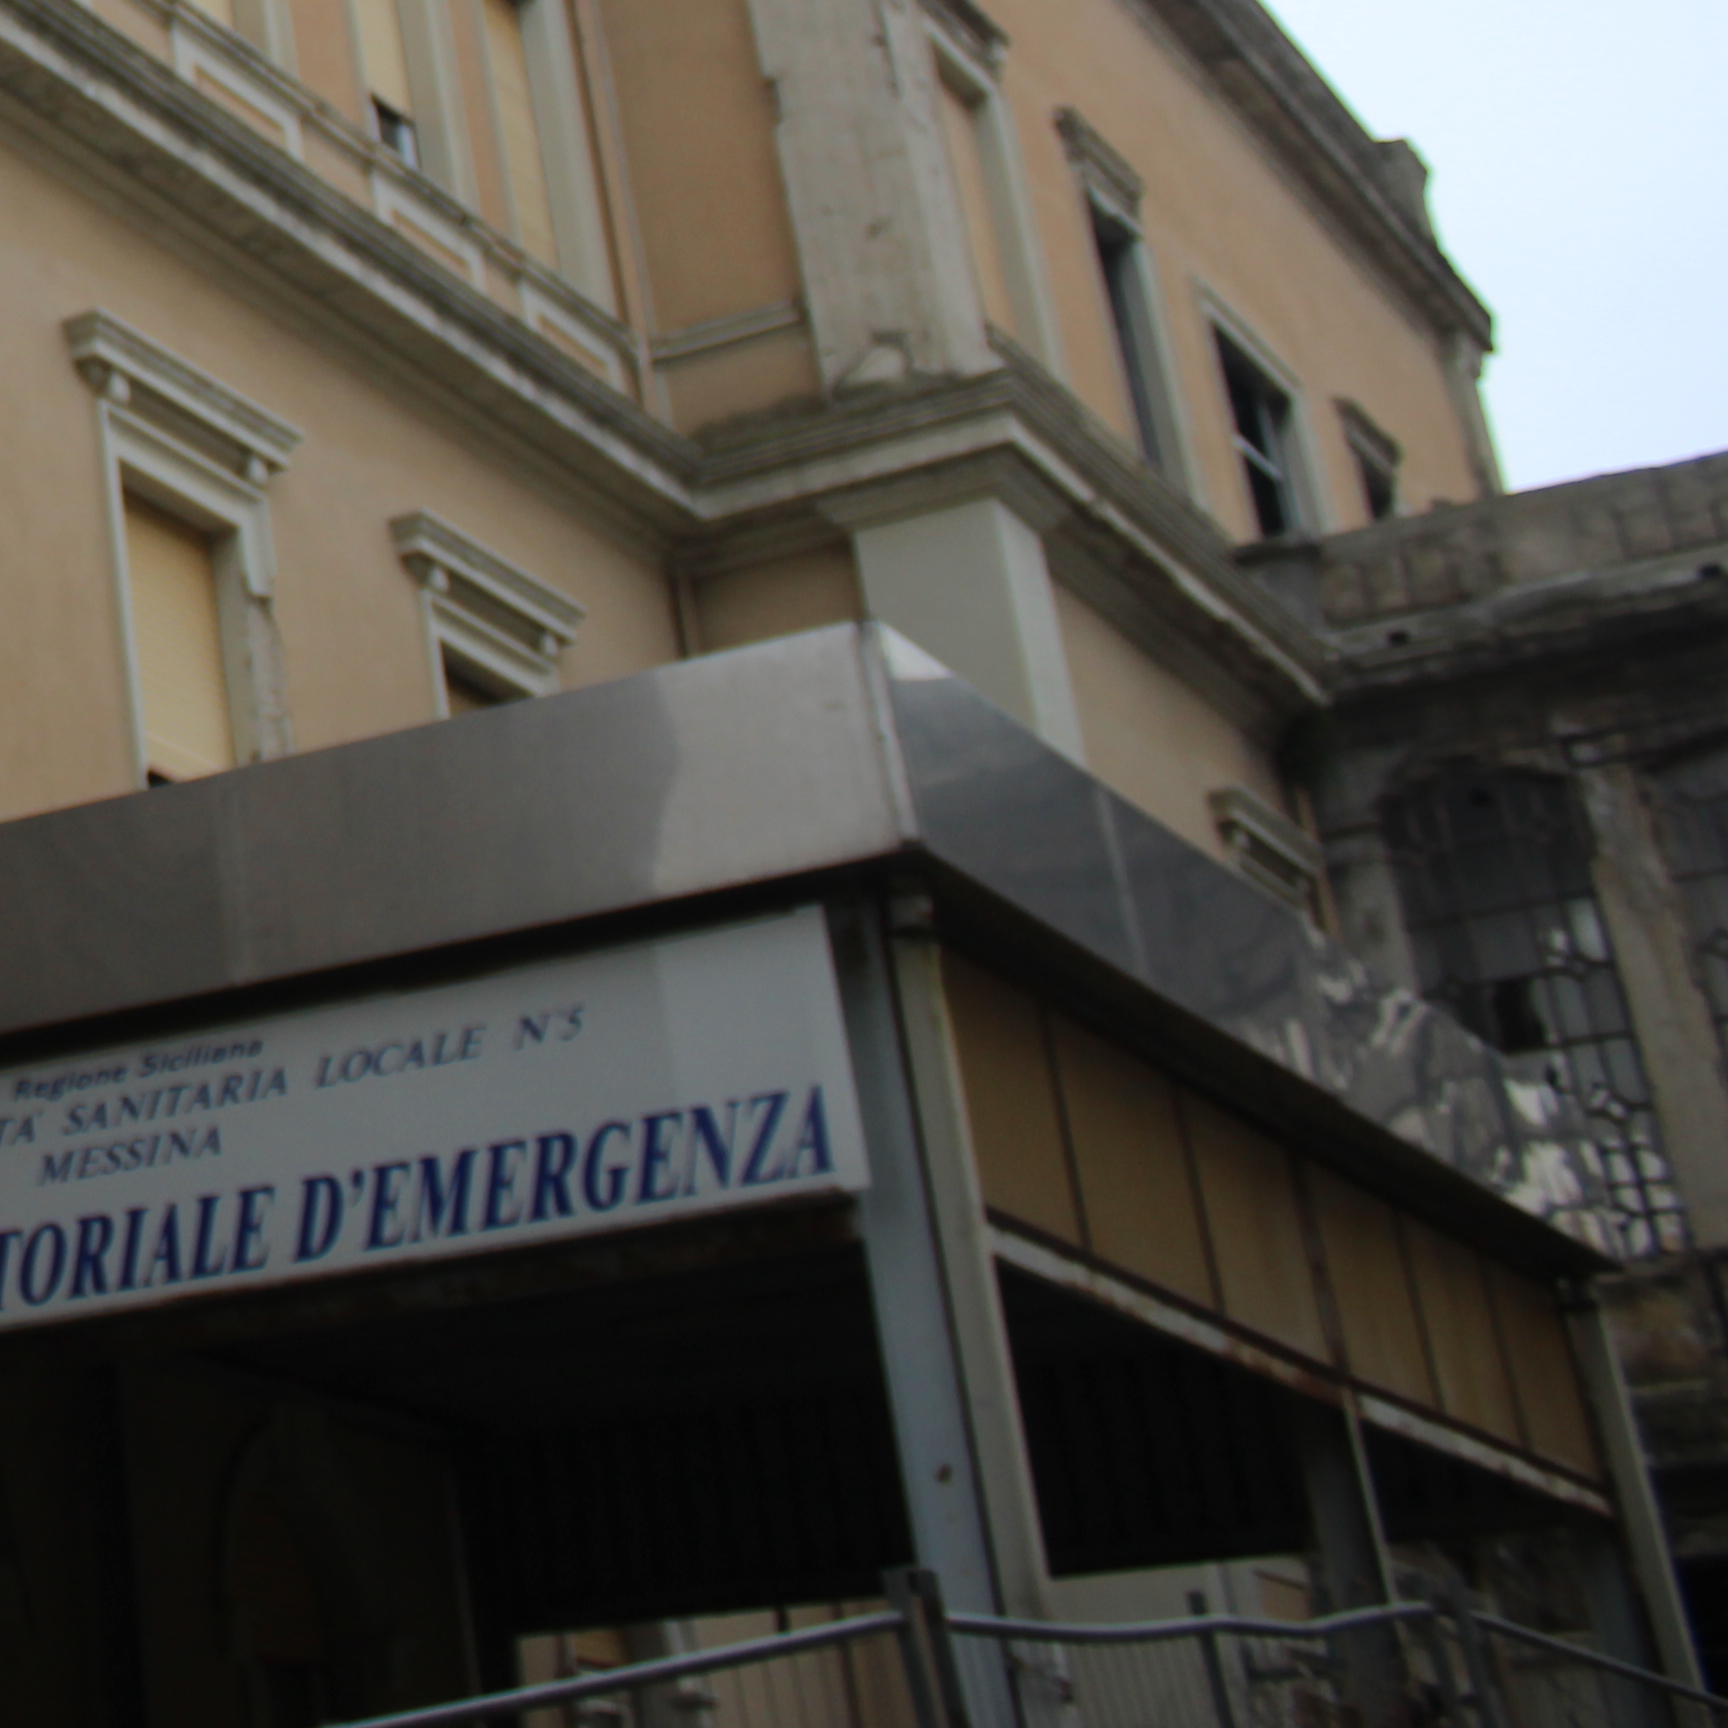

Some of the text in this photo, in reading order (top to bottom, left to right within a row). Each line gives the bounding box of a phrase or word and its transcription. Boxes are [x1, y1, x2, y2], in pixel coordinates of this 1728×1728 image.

[14, 1038, 263, 1102] Regione Siciliana
[62, 1066, 287, 1137] SANITARIA
[314, 1024, 487, 1089] LOCALE
[40, 1124, 223, 1187] MESSINA
[292, 1083, 836, 1264] D'EMERGENZA
